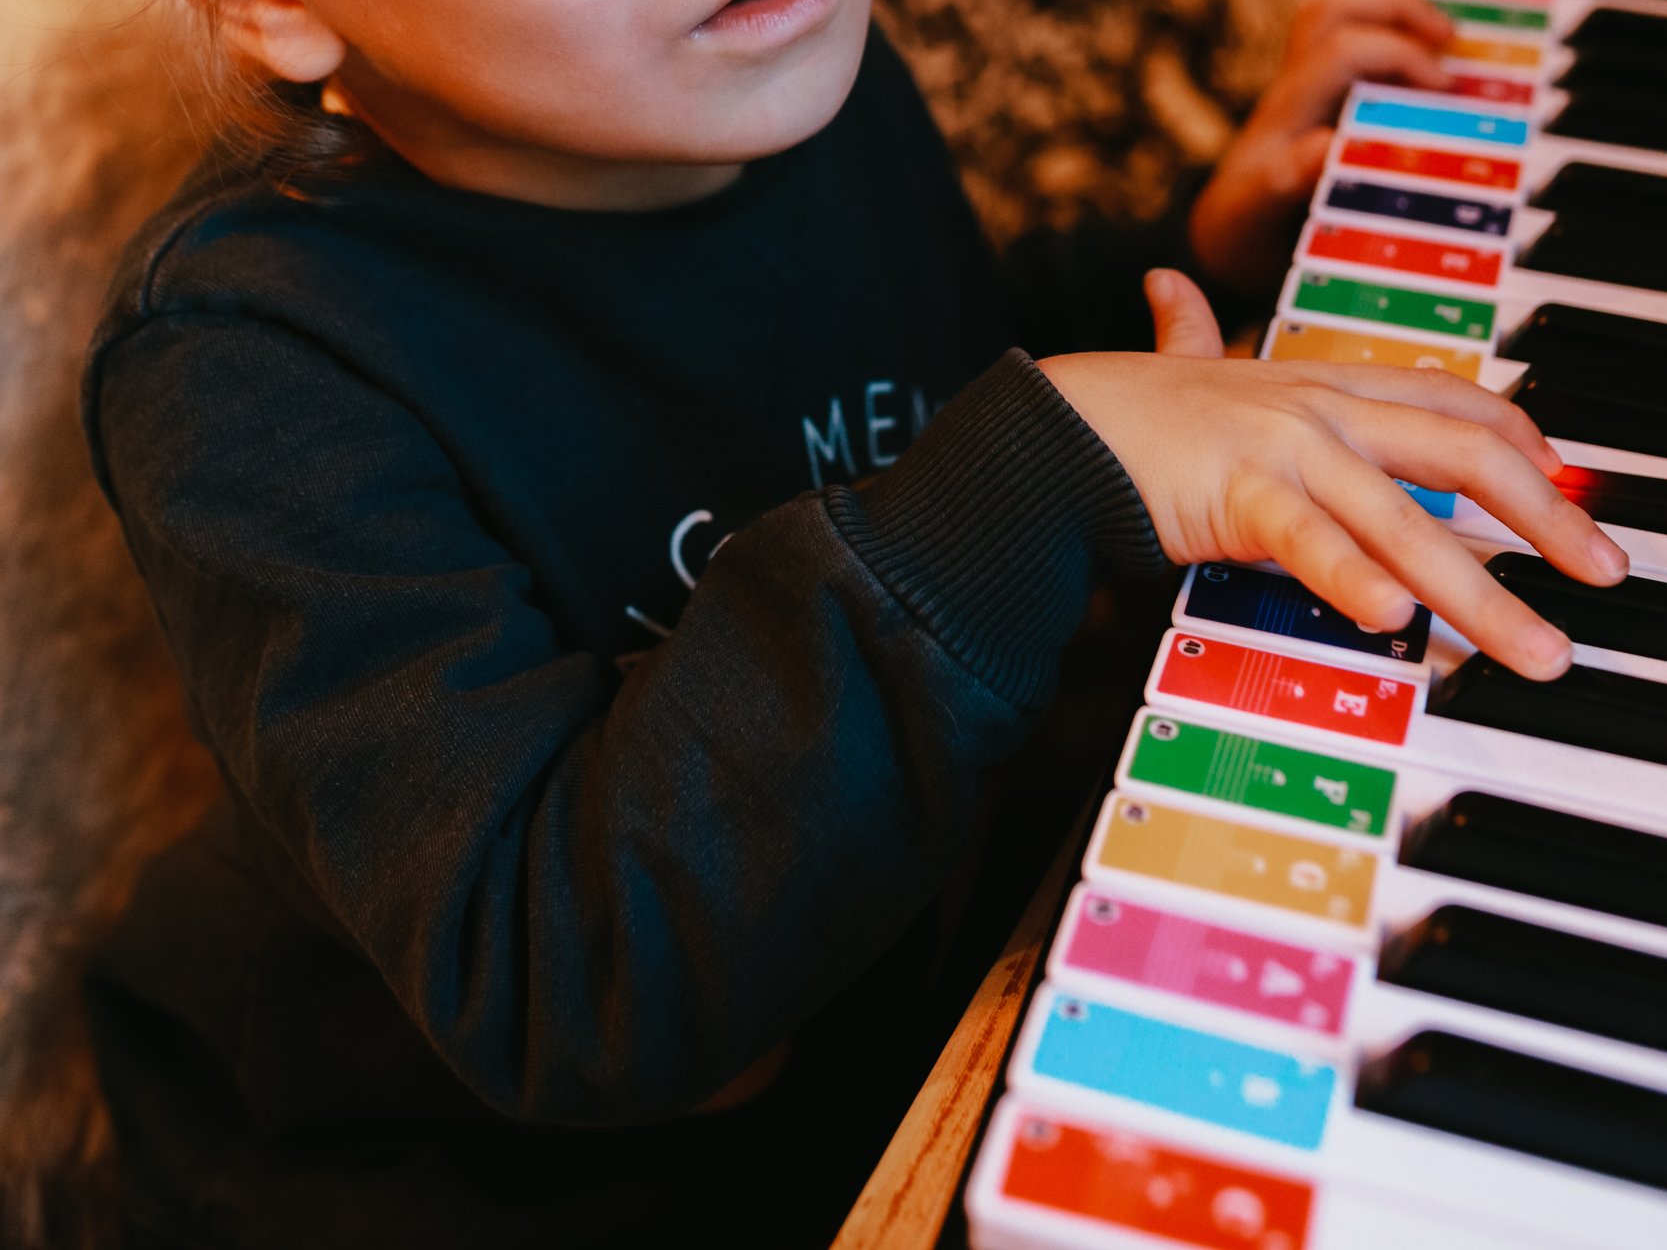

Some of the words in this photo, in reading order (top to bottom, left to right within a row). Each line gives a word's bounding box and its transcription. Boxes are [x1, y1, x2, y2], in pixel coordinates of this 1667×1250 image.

[1181, 639, 1202, 657] 40
[1333, 689, 1369, 717] E
[1313, 775, 1348, 805] F
